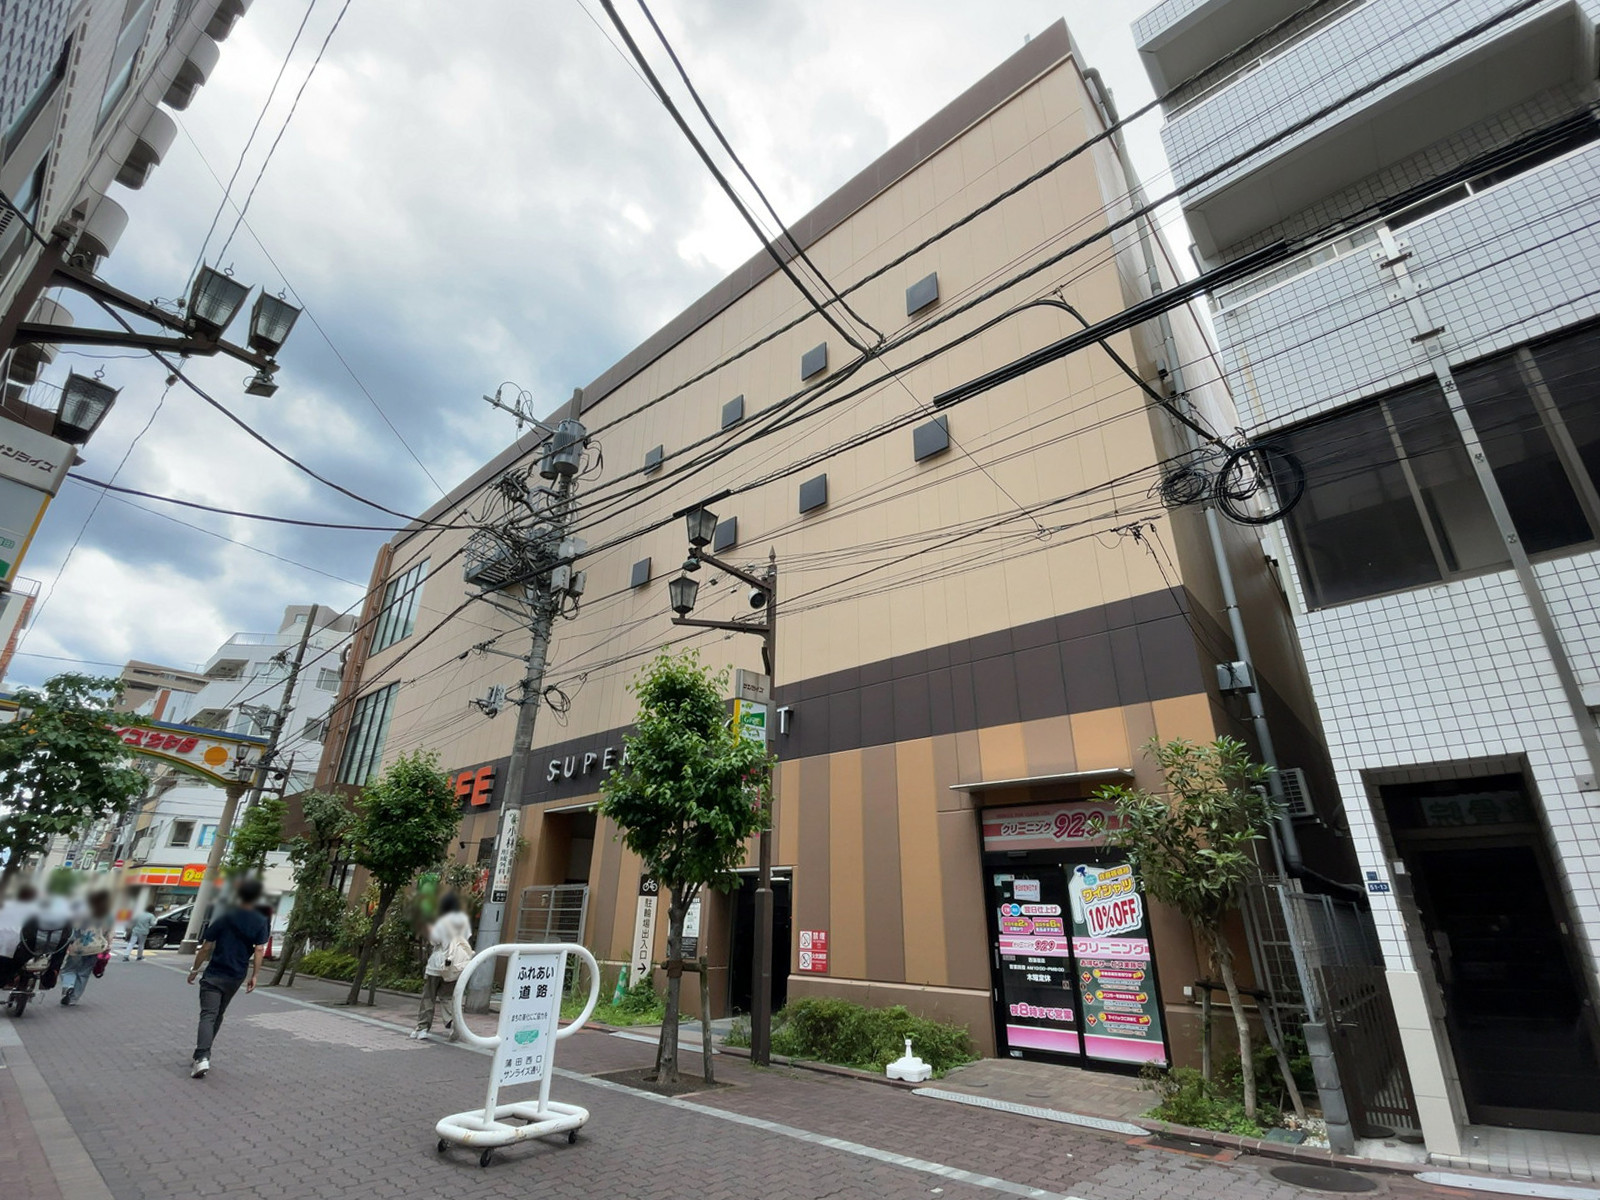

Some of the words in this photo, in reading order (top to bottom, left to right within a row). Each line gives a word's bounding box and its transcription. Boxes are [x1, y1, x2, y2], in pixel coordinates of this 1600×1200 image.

[1081, 877, 1133, 903] ワイシャツ
[1088, 898, 1136, 932] 10%OFF
[640, 898, 653, 960] 駐輪場出入口
[1034, 940, 1056, 952] 929
[1078, 942, 1144, 955] クリーニング
[518, 966, 555, 981] ふれあい
[518, 984, 548, 1000] 道路
[1009, 1002, 1074, 1021] 夜8時まで営業
[503, 1066, 541, 1079] サンライズ通り
